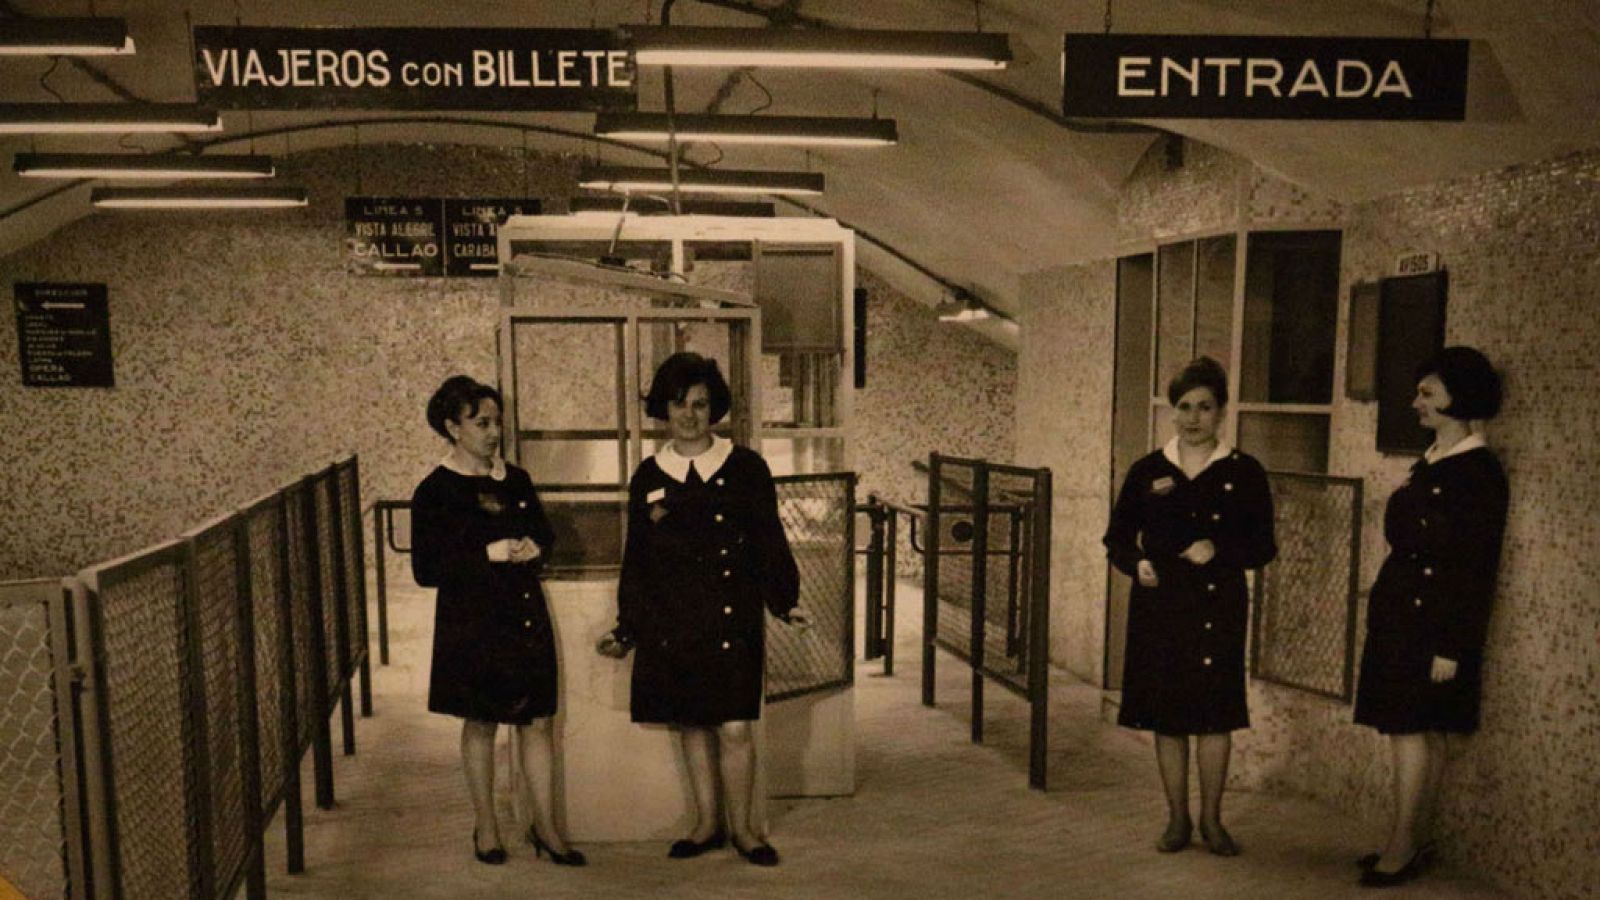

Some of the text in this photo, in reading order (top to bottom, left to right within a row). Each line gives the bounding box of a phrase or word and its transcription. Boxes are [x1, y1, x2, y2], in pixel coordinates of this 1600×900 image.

[202, 48, 391, 87] VIAJEROS
[473, 49, 632, 87] BILLETE
[1117, 57, 1413, 98] ENTRADA
[355, 222, 386, 236] VISTA
[453, 223, 485, 236] VISTA
[354, 243, 439, 257] CALLAO
[454, 243, 497, 257] CARABA
